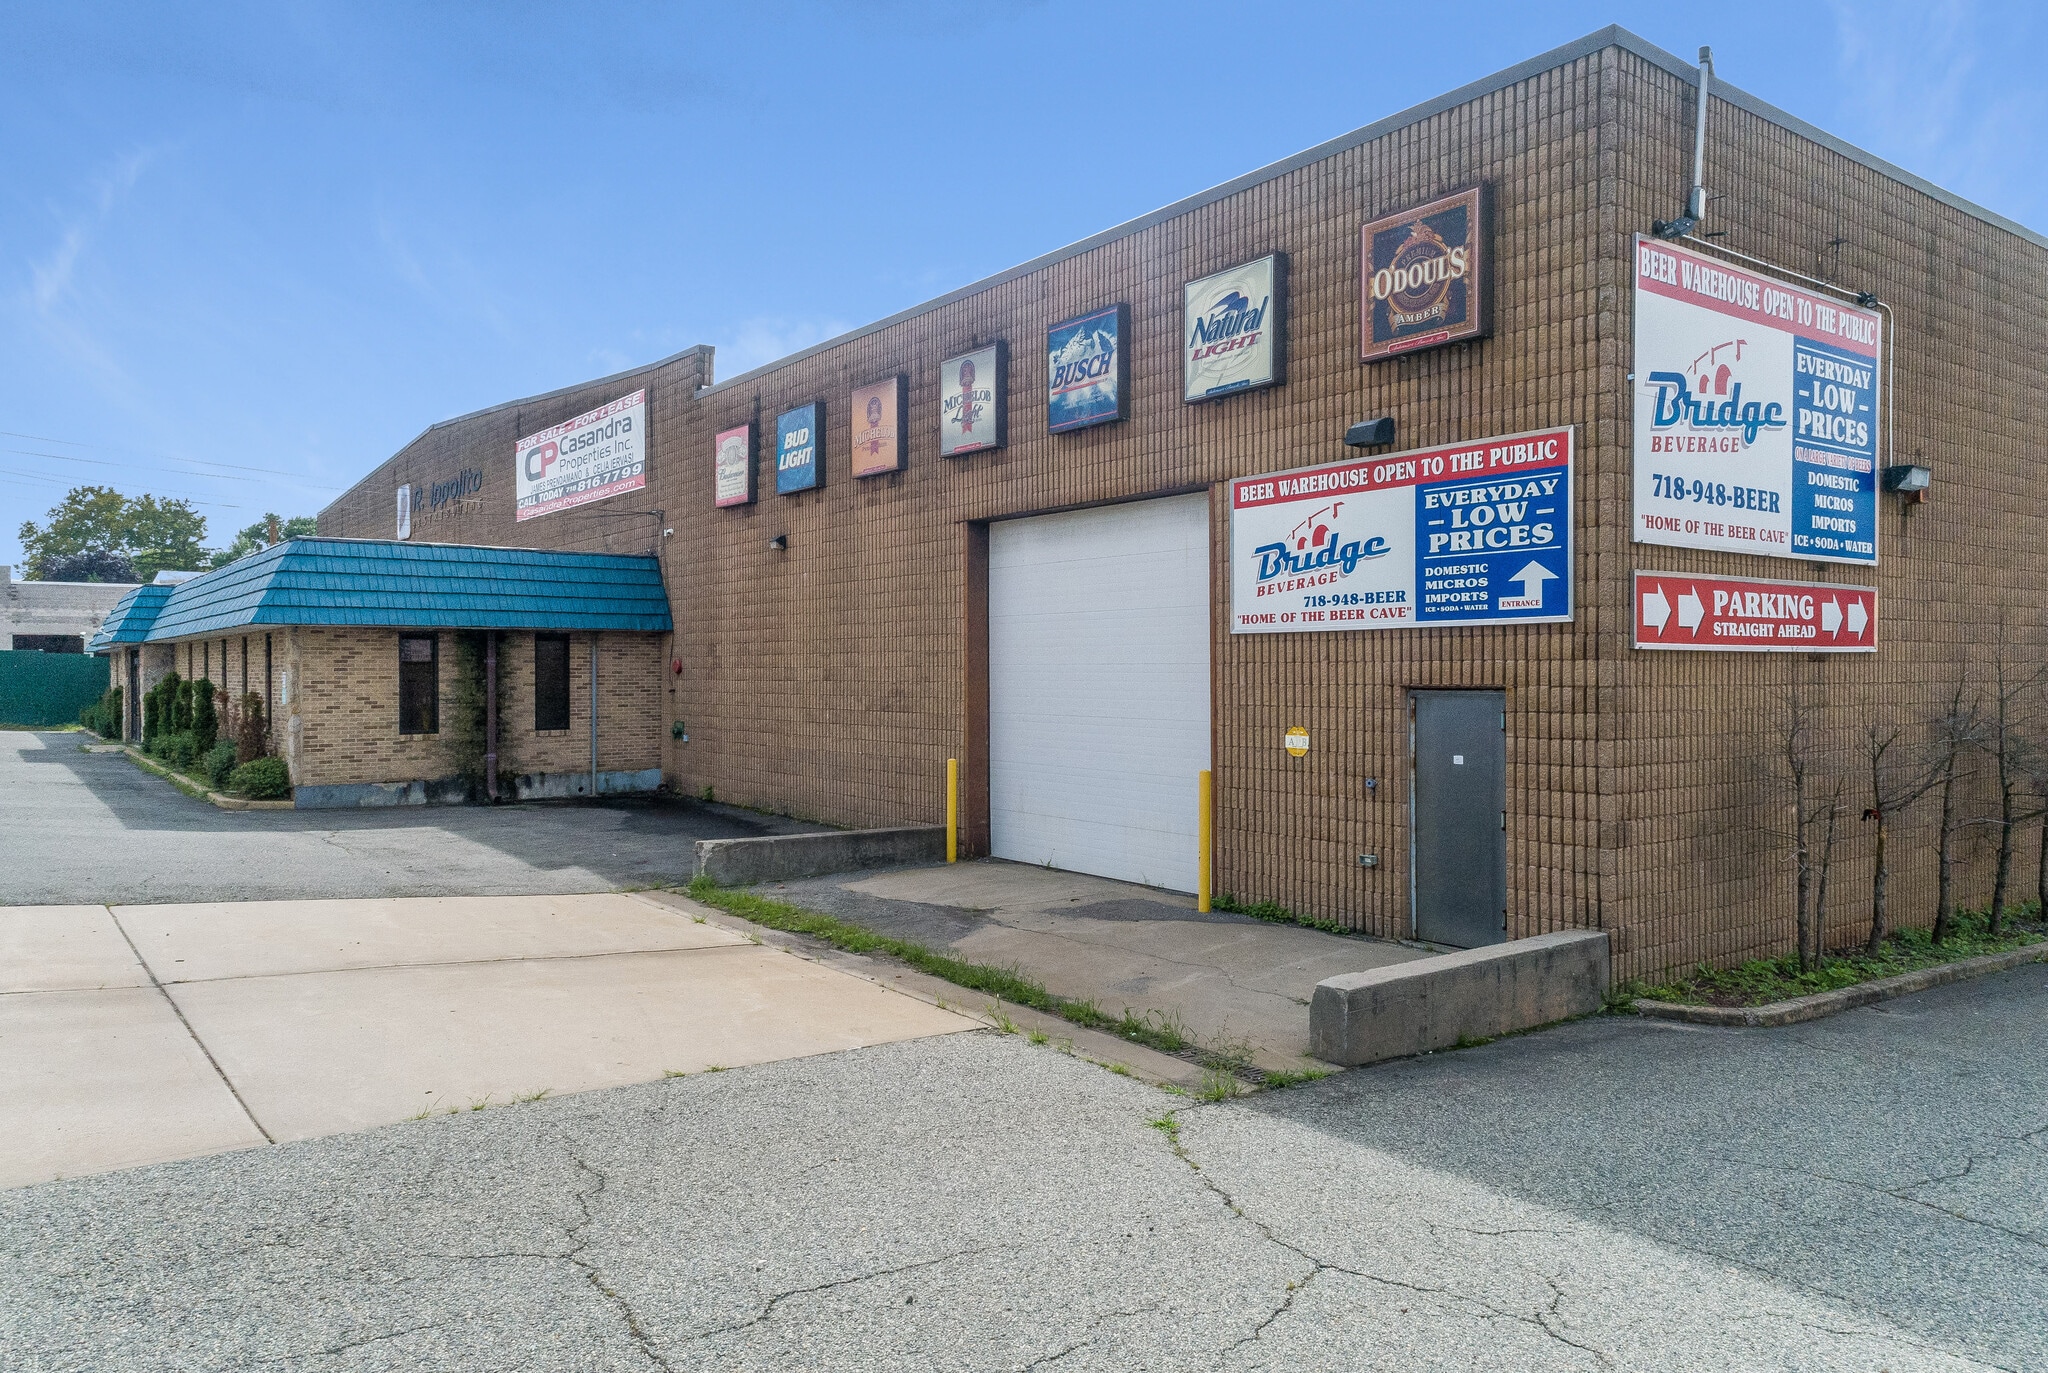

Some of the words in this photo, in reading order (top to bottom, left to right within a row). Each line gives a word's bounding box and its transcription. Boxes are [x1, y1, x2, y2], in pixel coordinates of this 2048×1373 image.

[1373, 245, 1465, 300] O'DOUL'S
[1640, 246, 1677, 286] BEER
[1681, 260, 1760, 311] WAREHOUSE
[1763, 287, 1795, 321] OPEN
[1797, 298, 1812, 327] TO
[1815, 304, 1836, 334] THE
[1838, 311, 1875, 346] PUBLIC
[1188, 296, 1269, 349] Natural
[1397, 305, 1440, 324] AMBER
[1191, 331, 1262, 361] LIGHT
[1051, 350, 1114, 389] BUSCH
[1797, 352, 1871, 390] EVERYDAY
[518, 436, 538, 452] FOR
[540, 425, 566, 444] SALE
[574, 412, 598, 429] FOR
[600, 393, 641, 418] LEASE
[1645, 371, 1787, 447] Bridge
[560, 416, 632, 456] Casandra
[783, 427, 809, 450] BUD
[1799, 408, 1869, 447] PRICES
[560, 445, 611, 472] Properties
[614, 438, 633, 454] Inc.
[779, 446, 813, 471] LIGHT
[1651, 436, 1739, 453] BEVERAGE
[1240, 482, 1275, 503] BEER
[1278, 468, 1369, 497] WAREHOUSE
[1373, 461, 1417, 483] OPEN
[1421, 456, 1444, 477] TO
[1450, 450, 1484, 473] THE
[1489, 439, 1558, 467] PUBLIC
[1808, 471, 1859, 492] DOMESTIC
[518, 494, 537, 508] CALL
[539, 487, 564, 503] TODAY
[577, 463, 642, 492] 816.7799
[1425, 478, 1559, 510] EVERYDAY
[1652, 473, 1780, 514] 718-948-BEER
[1814, 494, 1854, 512] MICROS
[1685, 520, 1700, 534] OF
[1704, 521, 1724, 537] THE
[1728, 525, 1756, 540] BEER
[1812, 515, 1856, 533] IMPORTS
[1428, 523, 1554, 554] PRICES
[1794, 534, 1809, 547] ICE
[1815, 536, 1839, 550] SODA
[1845, 540, 1873, 554] WATER
[1252, 532, 1391, 583] Bridge
[1425, 563, 1489, 577] DOMESTIC
[1257, 571, 1338, 598] BEVERAGE
[1425, 577, 1489, 590] MICROS
[1425, 591, 1489, 604] IMPORTS
[1303, 590, 1407, 608] 718-948-BEER
[1425, 605, 1436, 613] ICE
[1440, 604, 1459, 612] SODA
[1501, 599, 1541, 608] ENTRANCE
[1713, 590, 1815, 620] PARKING
[1281, 612, 1296, 623] OF
[1300, 611, 1325, 622] THE
[1329, 609, 1365, 621] BEER
[1713, 621, 1775, 638] STRAIGHT
[1778, 624, 1816, 638] AHEAD
